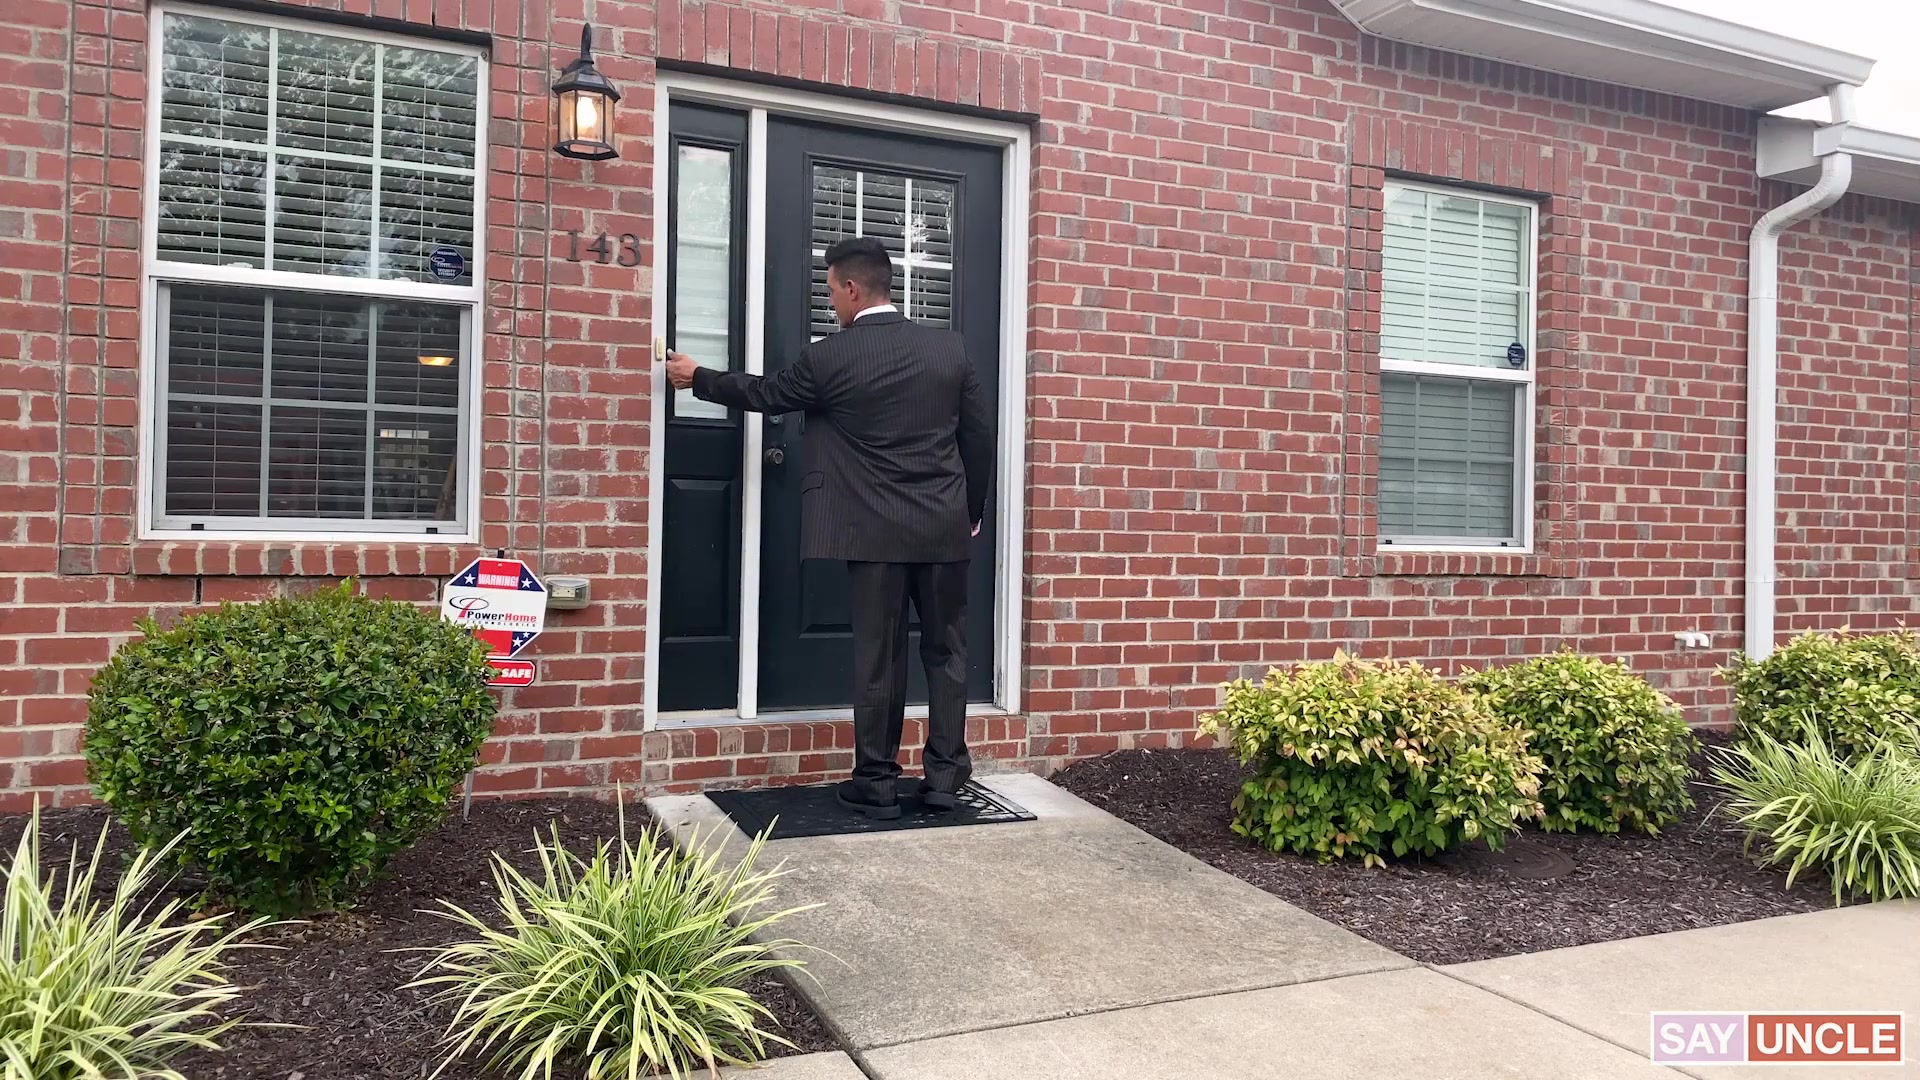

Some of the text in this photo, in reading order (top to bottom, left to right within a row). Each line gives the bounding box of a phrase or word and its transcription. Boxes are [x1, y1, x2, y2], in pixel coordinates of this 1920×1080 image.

[566, 228, 642, 267] 143
[478, 573, 519, 587] WARNING!
[467, 611, 537, 622] PowerHome
[501, 668, 532, 678] SAFE
